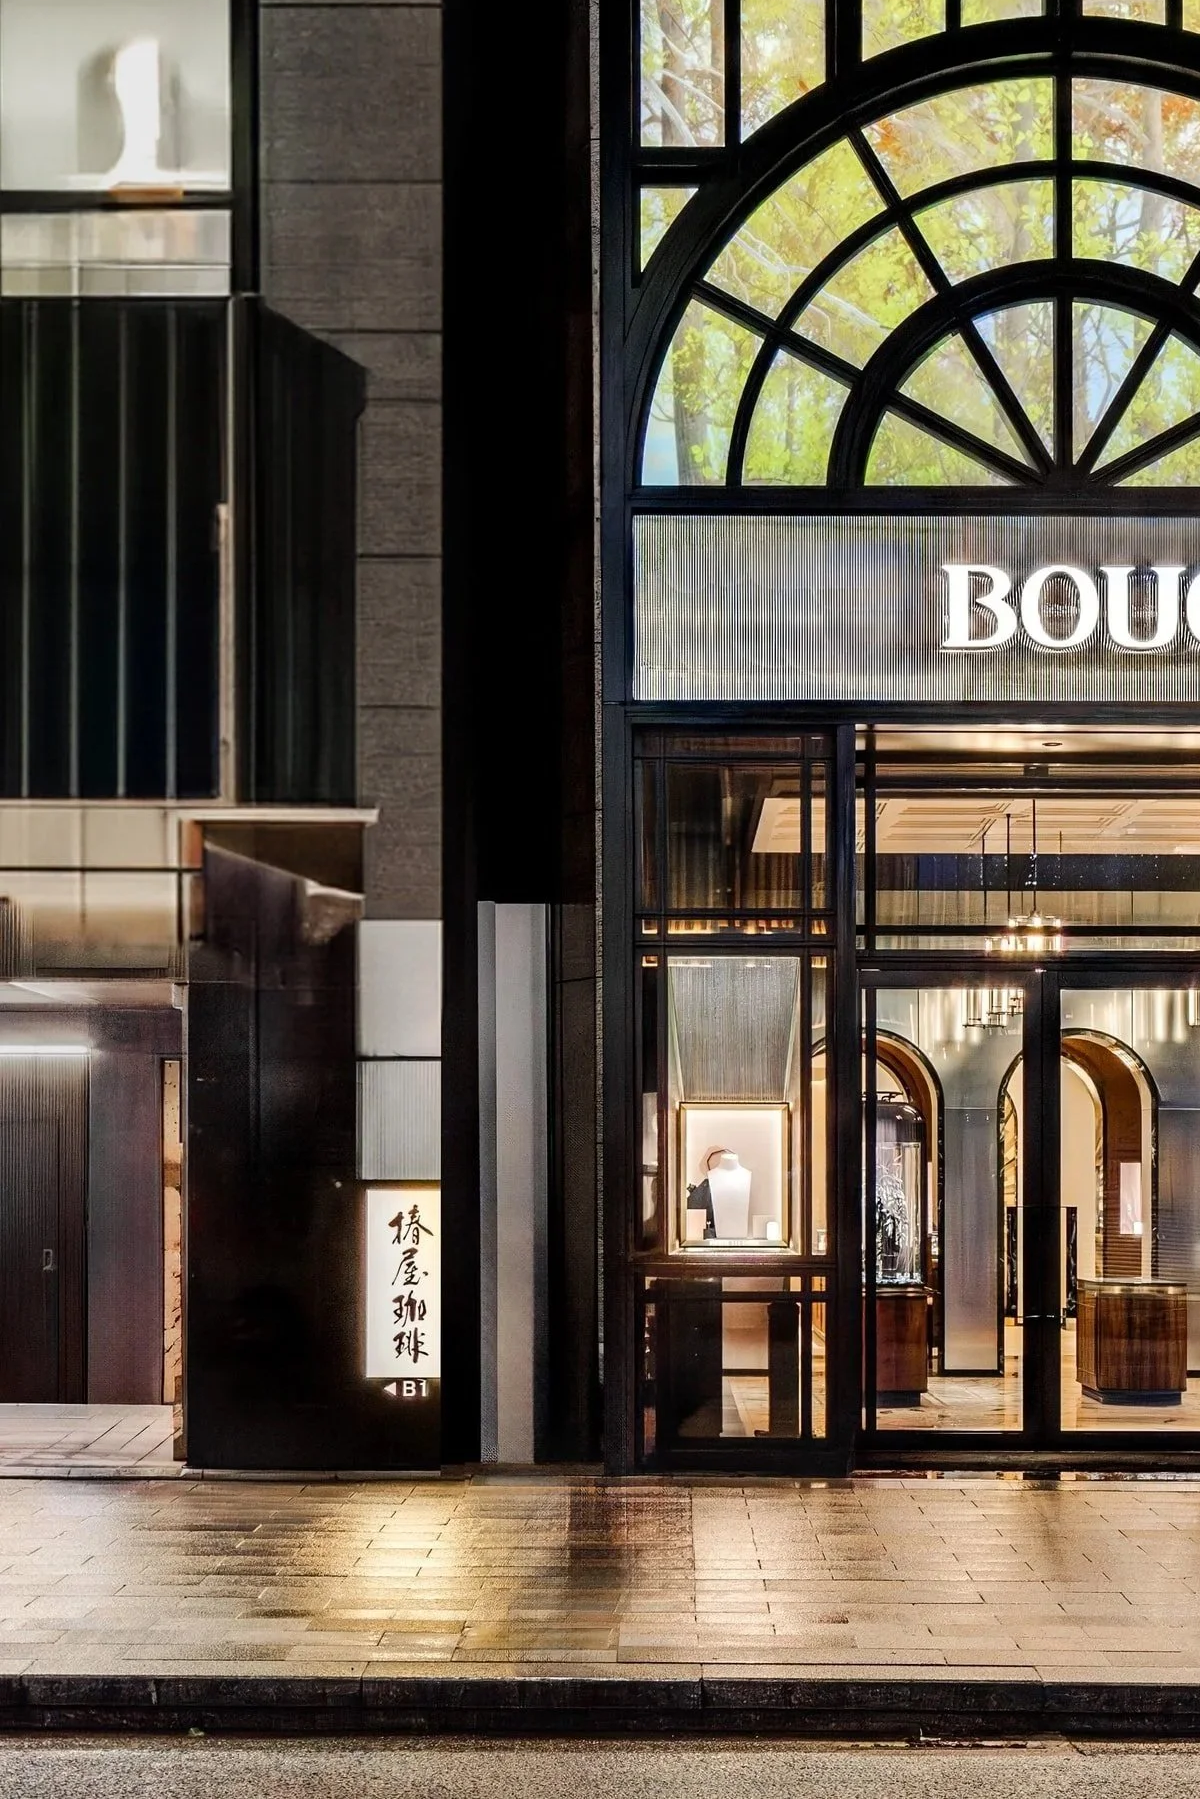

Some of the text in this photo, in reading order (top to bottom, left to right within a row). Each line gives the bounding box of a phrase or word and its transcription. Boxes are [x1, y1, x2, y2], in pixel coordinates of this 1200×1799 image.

[388, 1204, 434, 1364] 椿屋珈琲
[402, 1380, 429, 1398] B1
